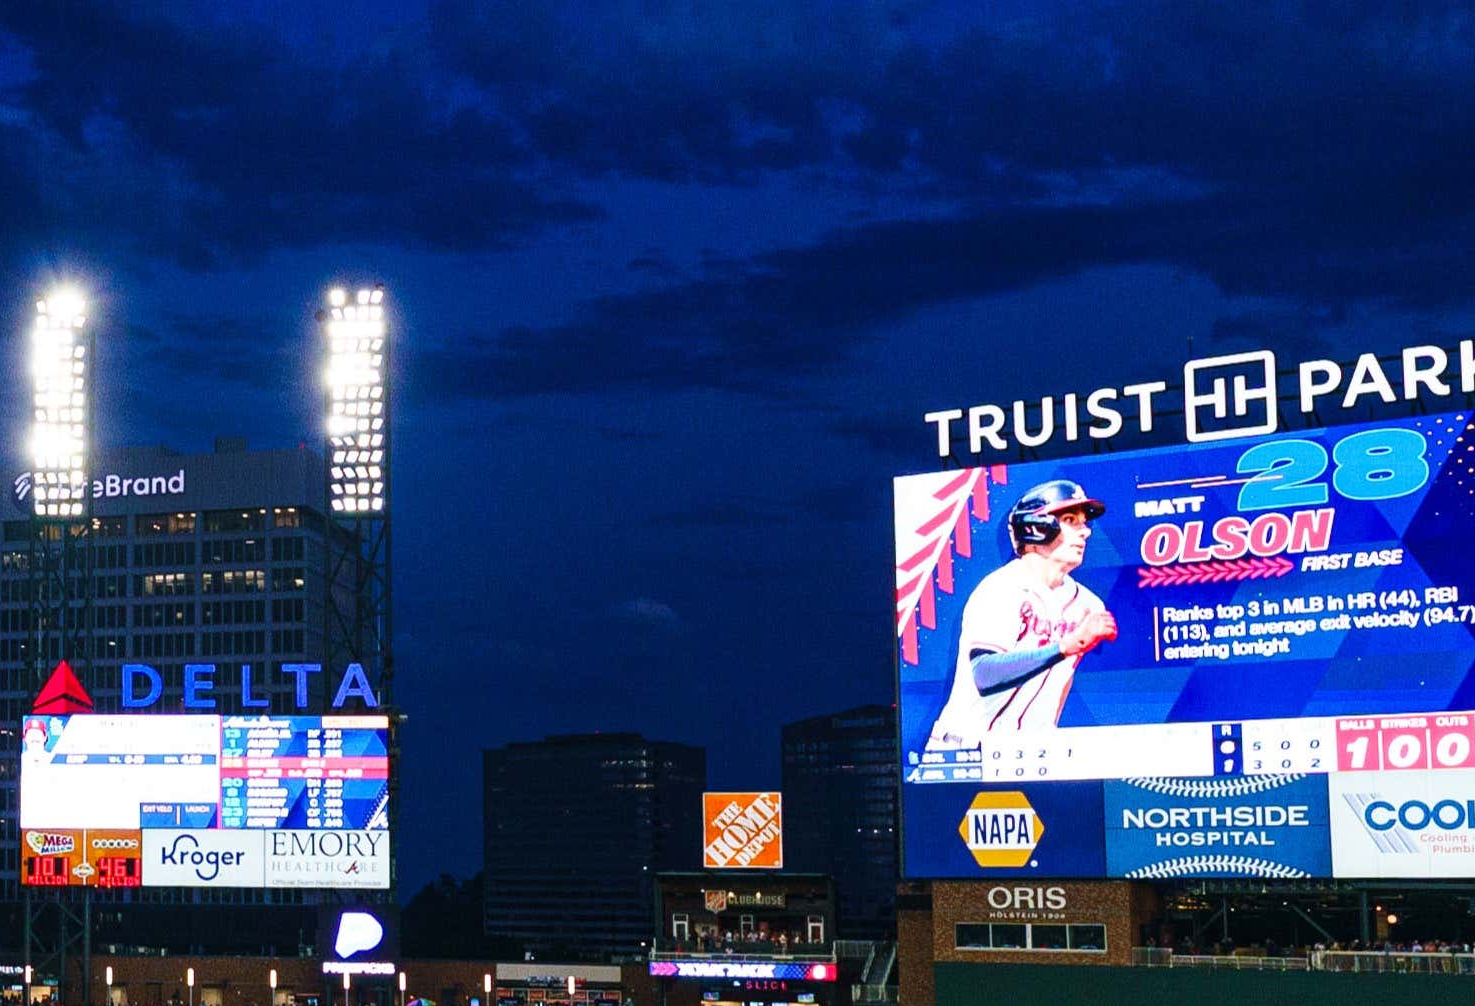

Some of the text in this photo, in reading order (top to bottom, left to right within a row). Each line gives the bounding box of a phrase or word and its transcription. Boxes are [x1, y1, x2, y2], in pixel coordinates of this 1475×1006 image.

[924, 381, 1166, 457] TRUIST
[1235, 428, 1427, 511] 28
[1134, 495, 1205, 518] MATT
[1140, 507, 1335, 567] OLSON
[1301, 549, 1403, 573] FIRST BASE
[1163, 604, 1214, 623] Ranks
[1216, 603, 1243, 624] top
[1264, 600, 1279, 616] in
[1283, 596, 1323, 615] MLB
[1327, 594, 1344, 612] in
[1348, 592, 1375, 611] HR
[1426, 586, 1459, 605] RBI
[1163, 622, 1210, 643] (113),
[1213, 620, 1246, 639] and
[1249, 617, 1316, 641] average
[1319, 613, 1351, 632] exit
[1354, 608, 1419, 633] velocity
[1163, 637, 1290, 662] entering tonight
[121, 663, 379, 709] DELTA
[1436, 715, 1469, 727] OUTS
[1388, 734, 1422, 768] 0
[712, 800, 743, 830] THE
[1123, 805, 1309, 829] NORTHSIDE
[43, 834, 73, 847] MEGA
[705, 793, 779, 867] HOME
[974, 813, 1030, 845] NAPA
[1155, 831, 1275, 847] HOSPITAL
[1420, 832, 1468, 844] Cooling
[162, 833, 245, 880] Kroger
[272, 832, 382, 857] EMORY
[735, 820, 780, 867] DEPOT
[28, 876, 68, 884] MILLION
[100, 876, 140, 886] MILLION
[987, 887, 1067, 910] ORIS
